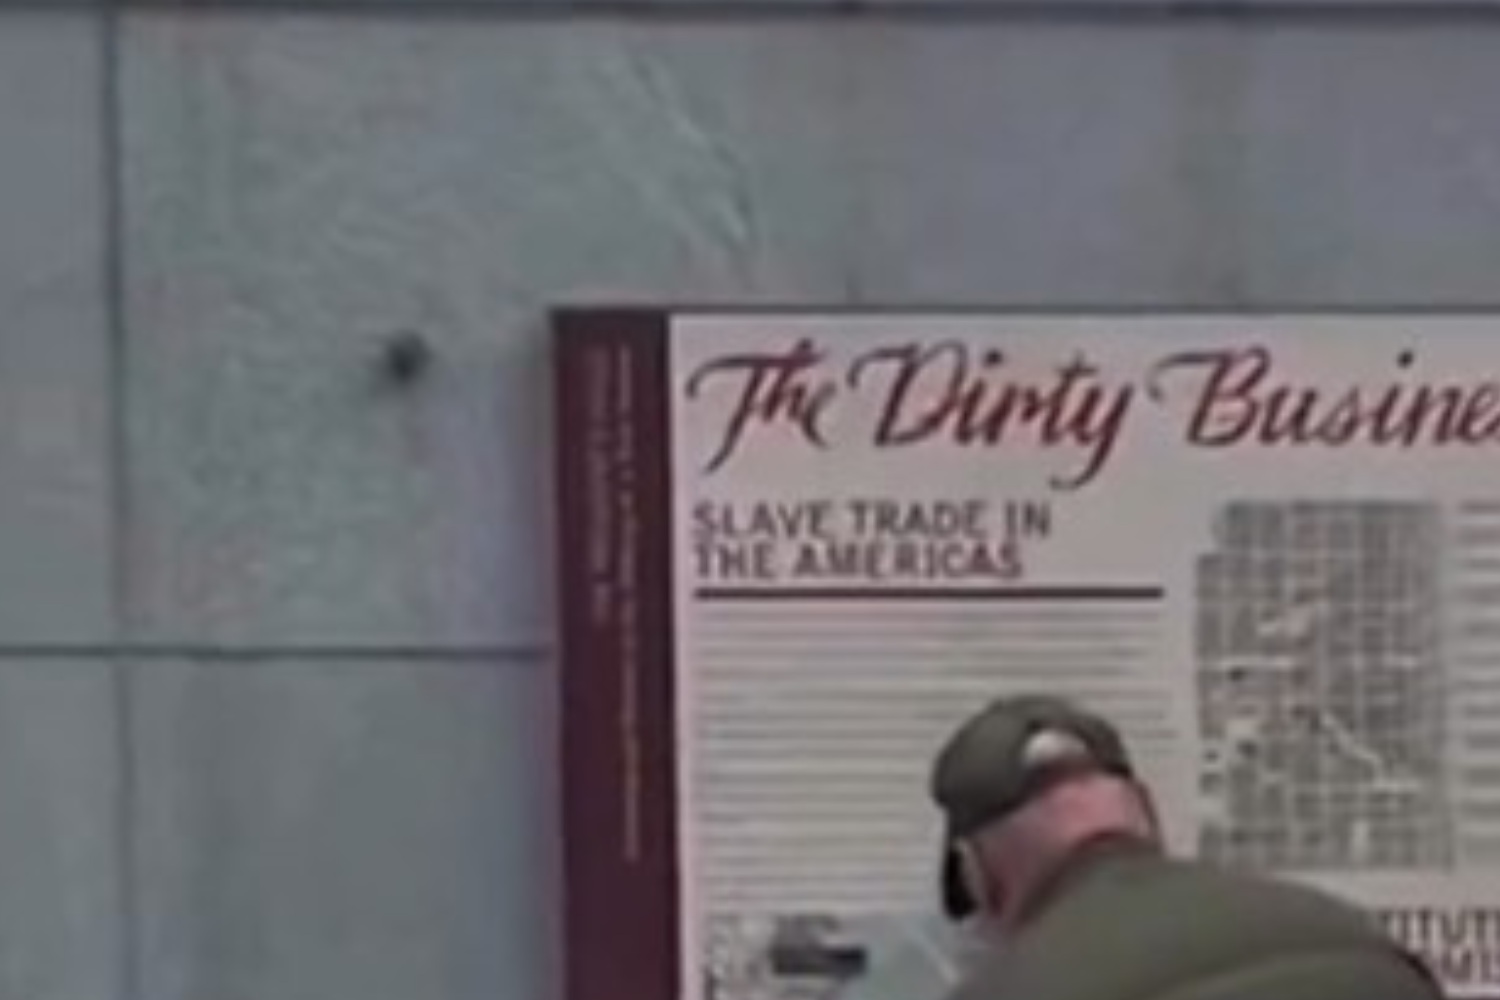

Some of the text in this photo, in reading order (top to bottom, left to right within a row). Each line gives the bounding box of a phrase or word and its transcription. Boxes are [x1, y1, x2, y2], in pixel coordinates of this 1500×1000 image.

[685, 338, 838, 476] The
[846, 338, 1135, 490] Dirty
[694, 502, 1052, 538] SLAVE TRADE IN
[694, 543, 1023, 579] THE AMERICAS
